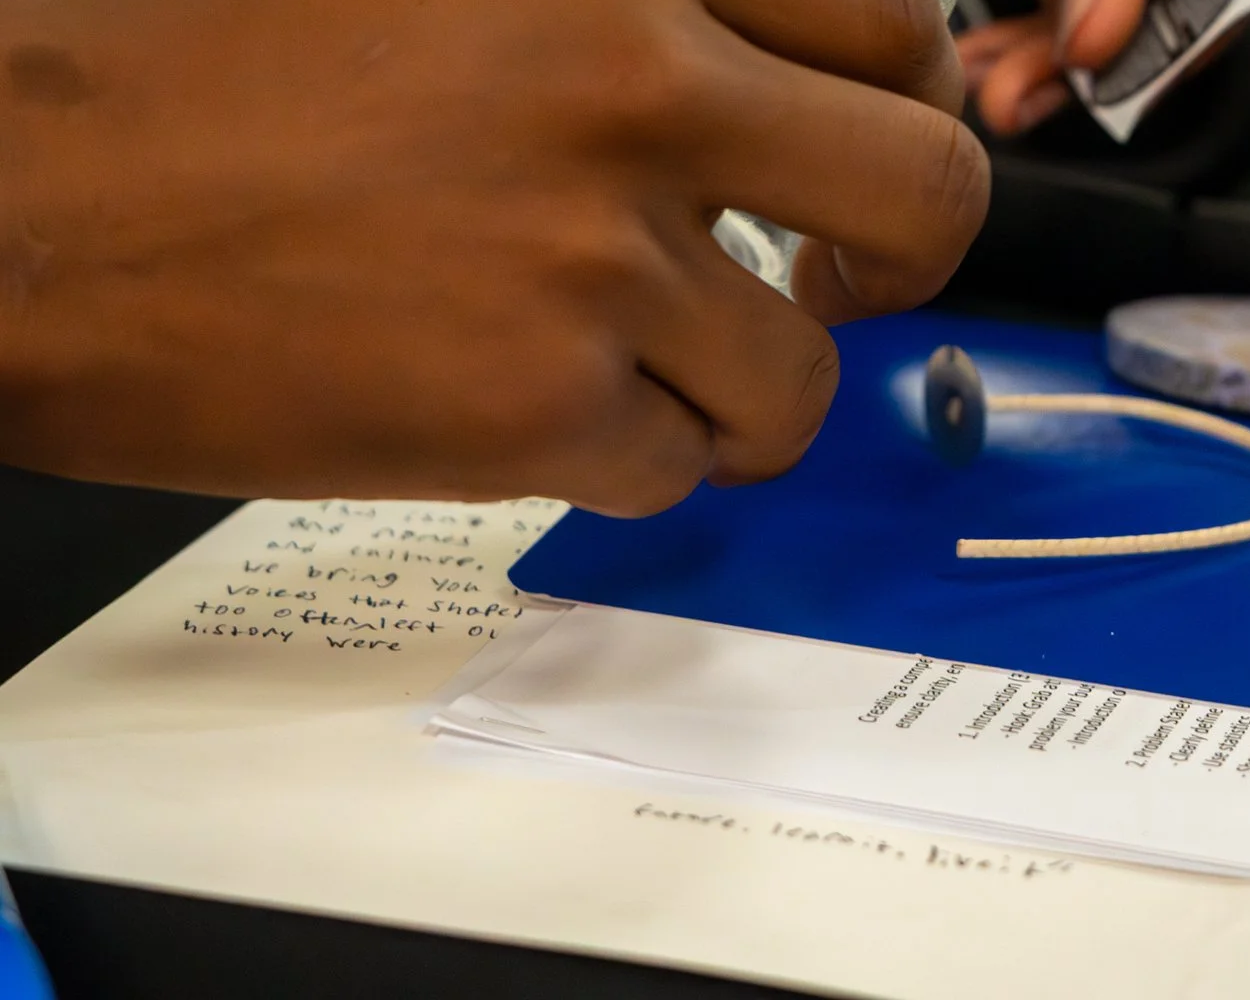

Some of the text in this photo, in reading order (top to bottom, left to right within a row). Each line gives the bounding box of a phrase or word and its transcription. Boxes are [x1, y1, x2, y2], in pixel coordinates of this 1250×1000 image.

[308, 564, 398, 588] bring
[194, 601, 246, 615] too
[184, 618, 401, 651] history were
[858, 691, 907, 723] Creating
[895, 702, 930, 729] ensure
[919, 676, 958, 701] clarity,
[964, 684, 1022, 730] Introduction
[1000, 709, 1035, 734] Hook:
[1022, 690, 1053, 709] Grab
[1066, 697, 1120, 745] Introduction
[1029, 717, 1068, 752] problem
[1056, 698, 1082, 717] your
[1133, 725, 1175, 758] Problem
[1169, 708, 1224, 761] Clearly define
[1202, 752, 1229, 768] Use
